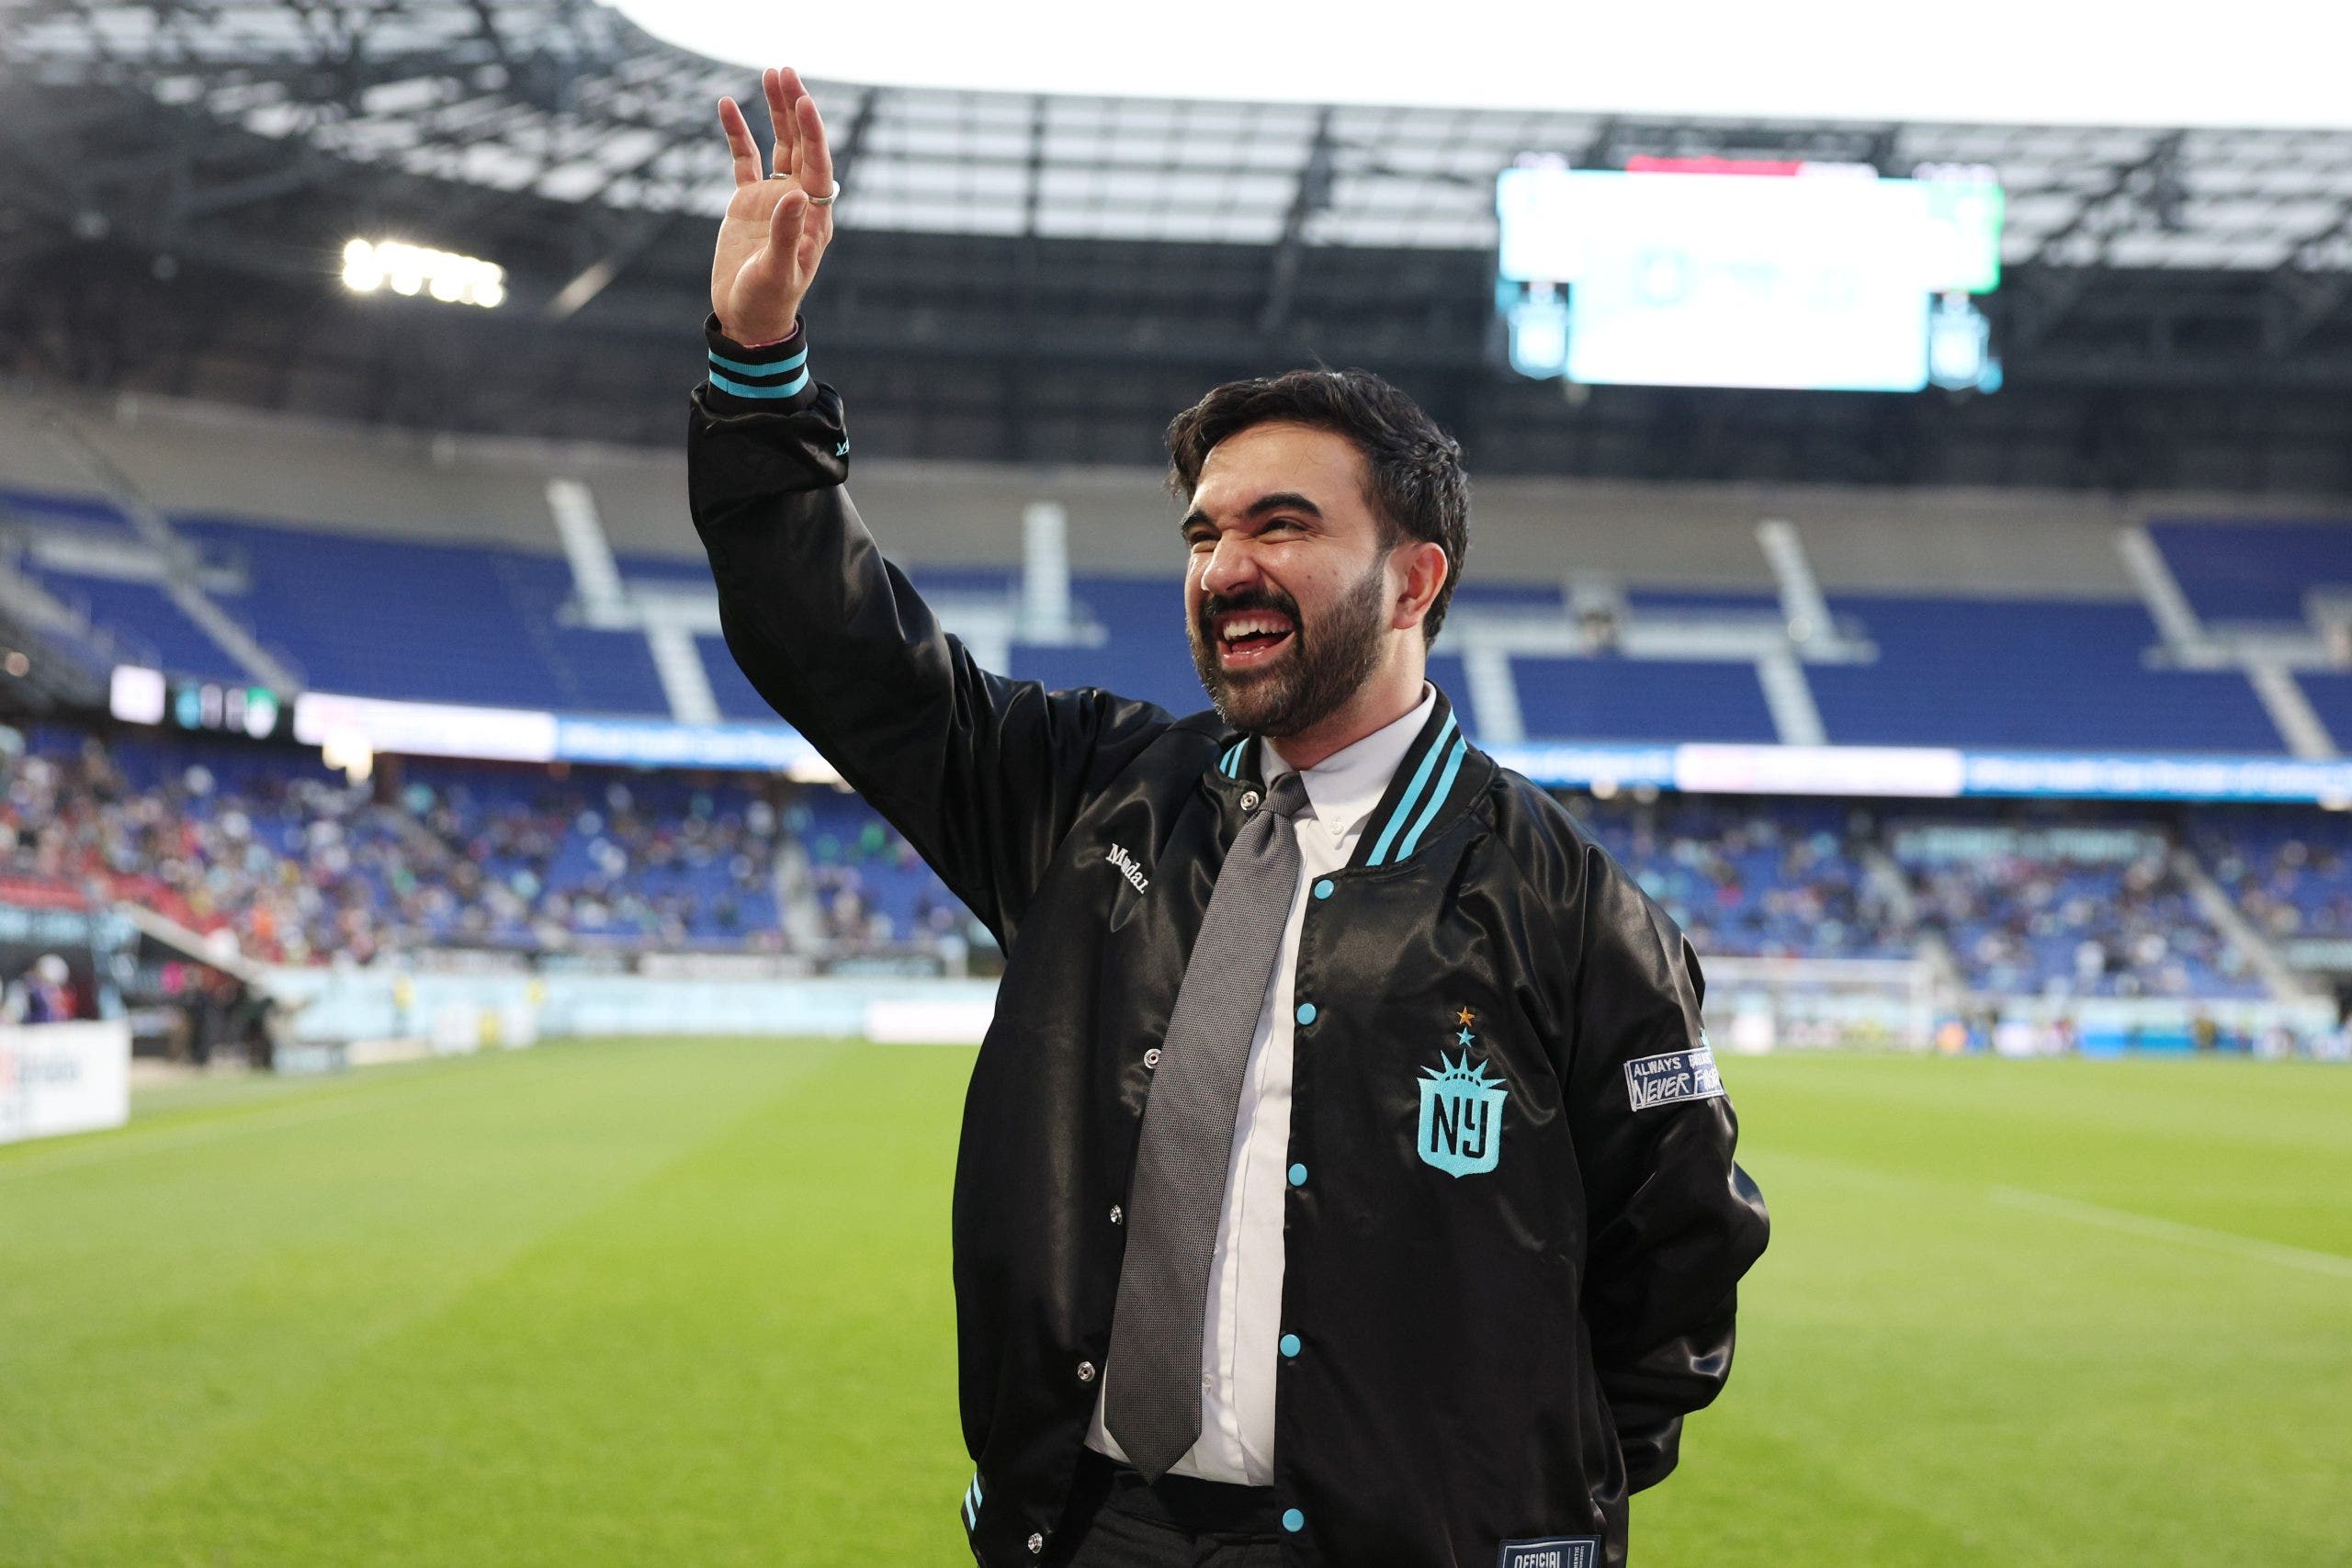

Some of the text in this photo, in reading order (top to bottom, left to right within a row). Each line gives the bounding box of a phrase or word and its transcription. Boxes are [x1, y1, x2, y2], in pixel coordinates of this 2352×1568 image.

[1634, 1056, 1682, 1077] ALWAYS
[1633, 1073, 1690, 1109] NEVER
[1430, 1092, 1489, 1159] NY
